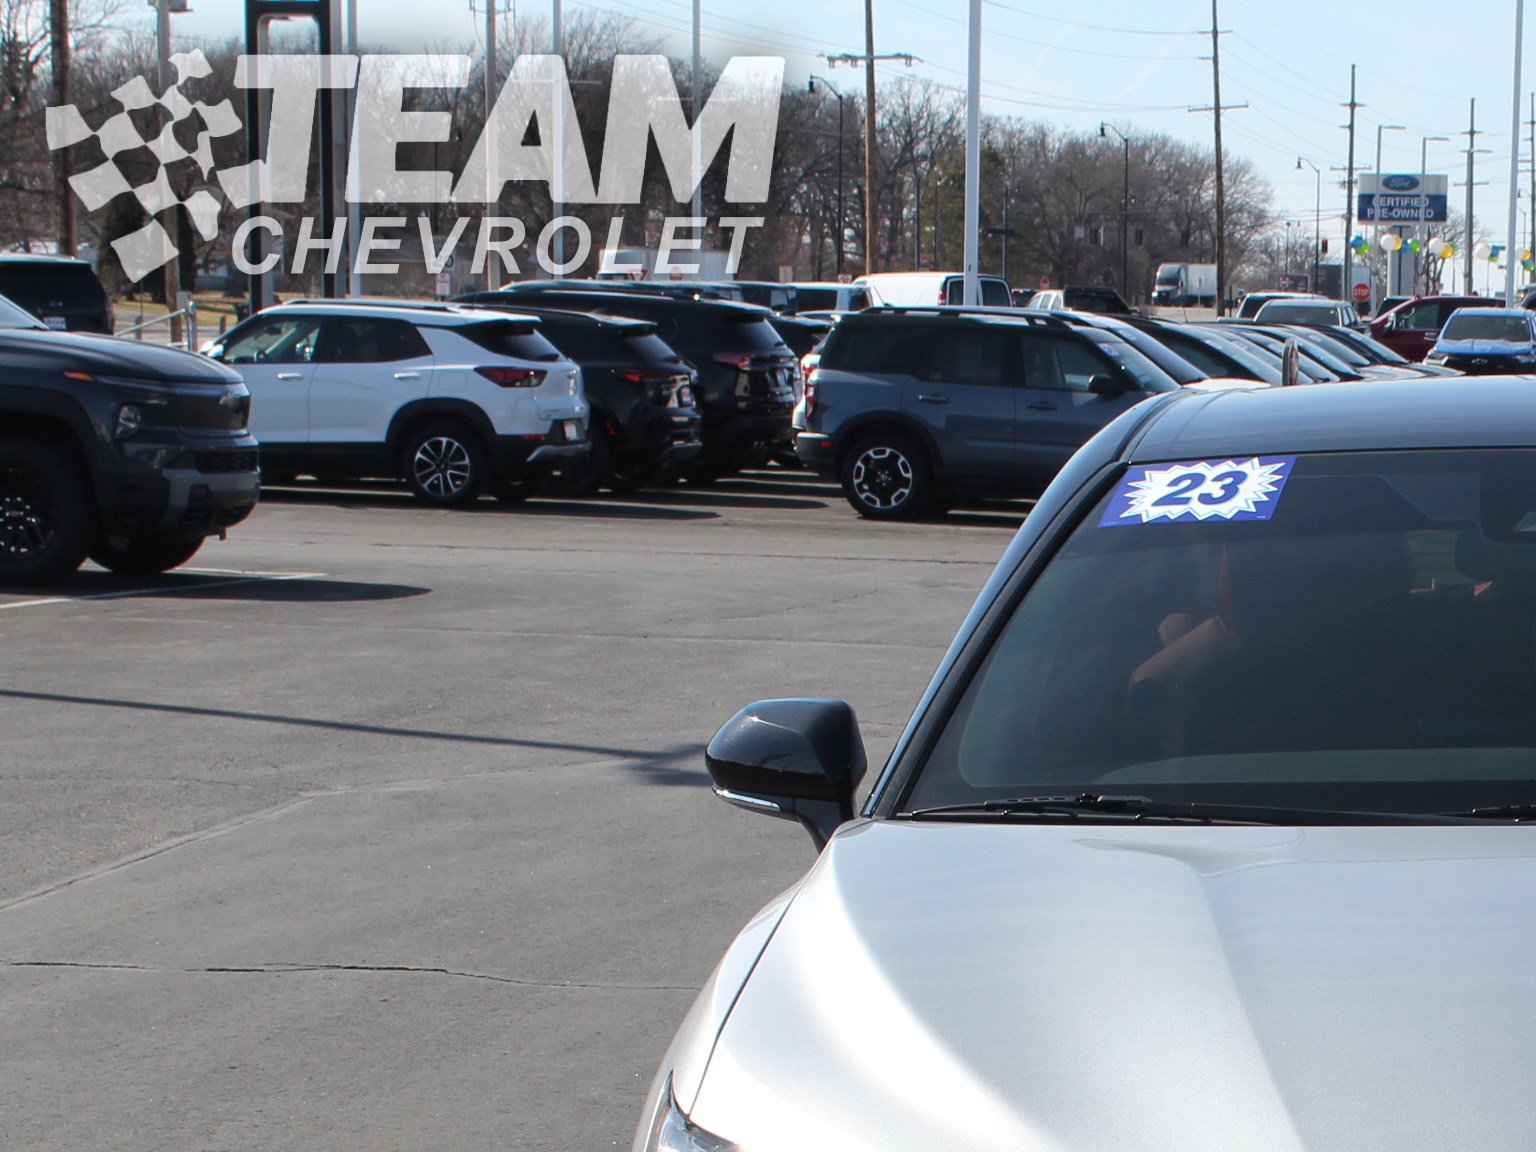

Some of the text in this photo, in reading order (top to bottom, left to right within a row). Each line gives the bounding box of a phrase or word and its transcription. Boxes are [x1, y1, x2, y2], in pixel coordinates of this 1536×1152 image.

[1366, 208, 1434, 219] PE-OWND
[1353, 288, 1370, 297] STOP
[1151, 470, 1248, 506] 23
